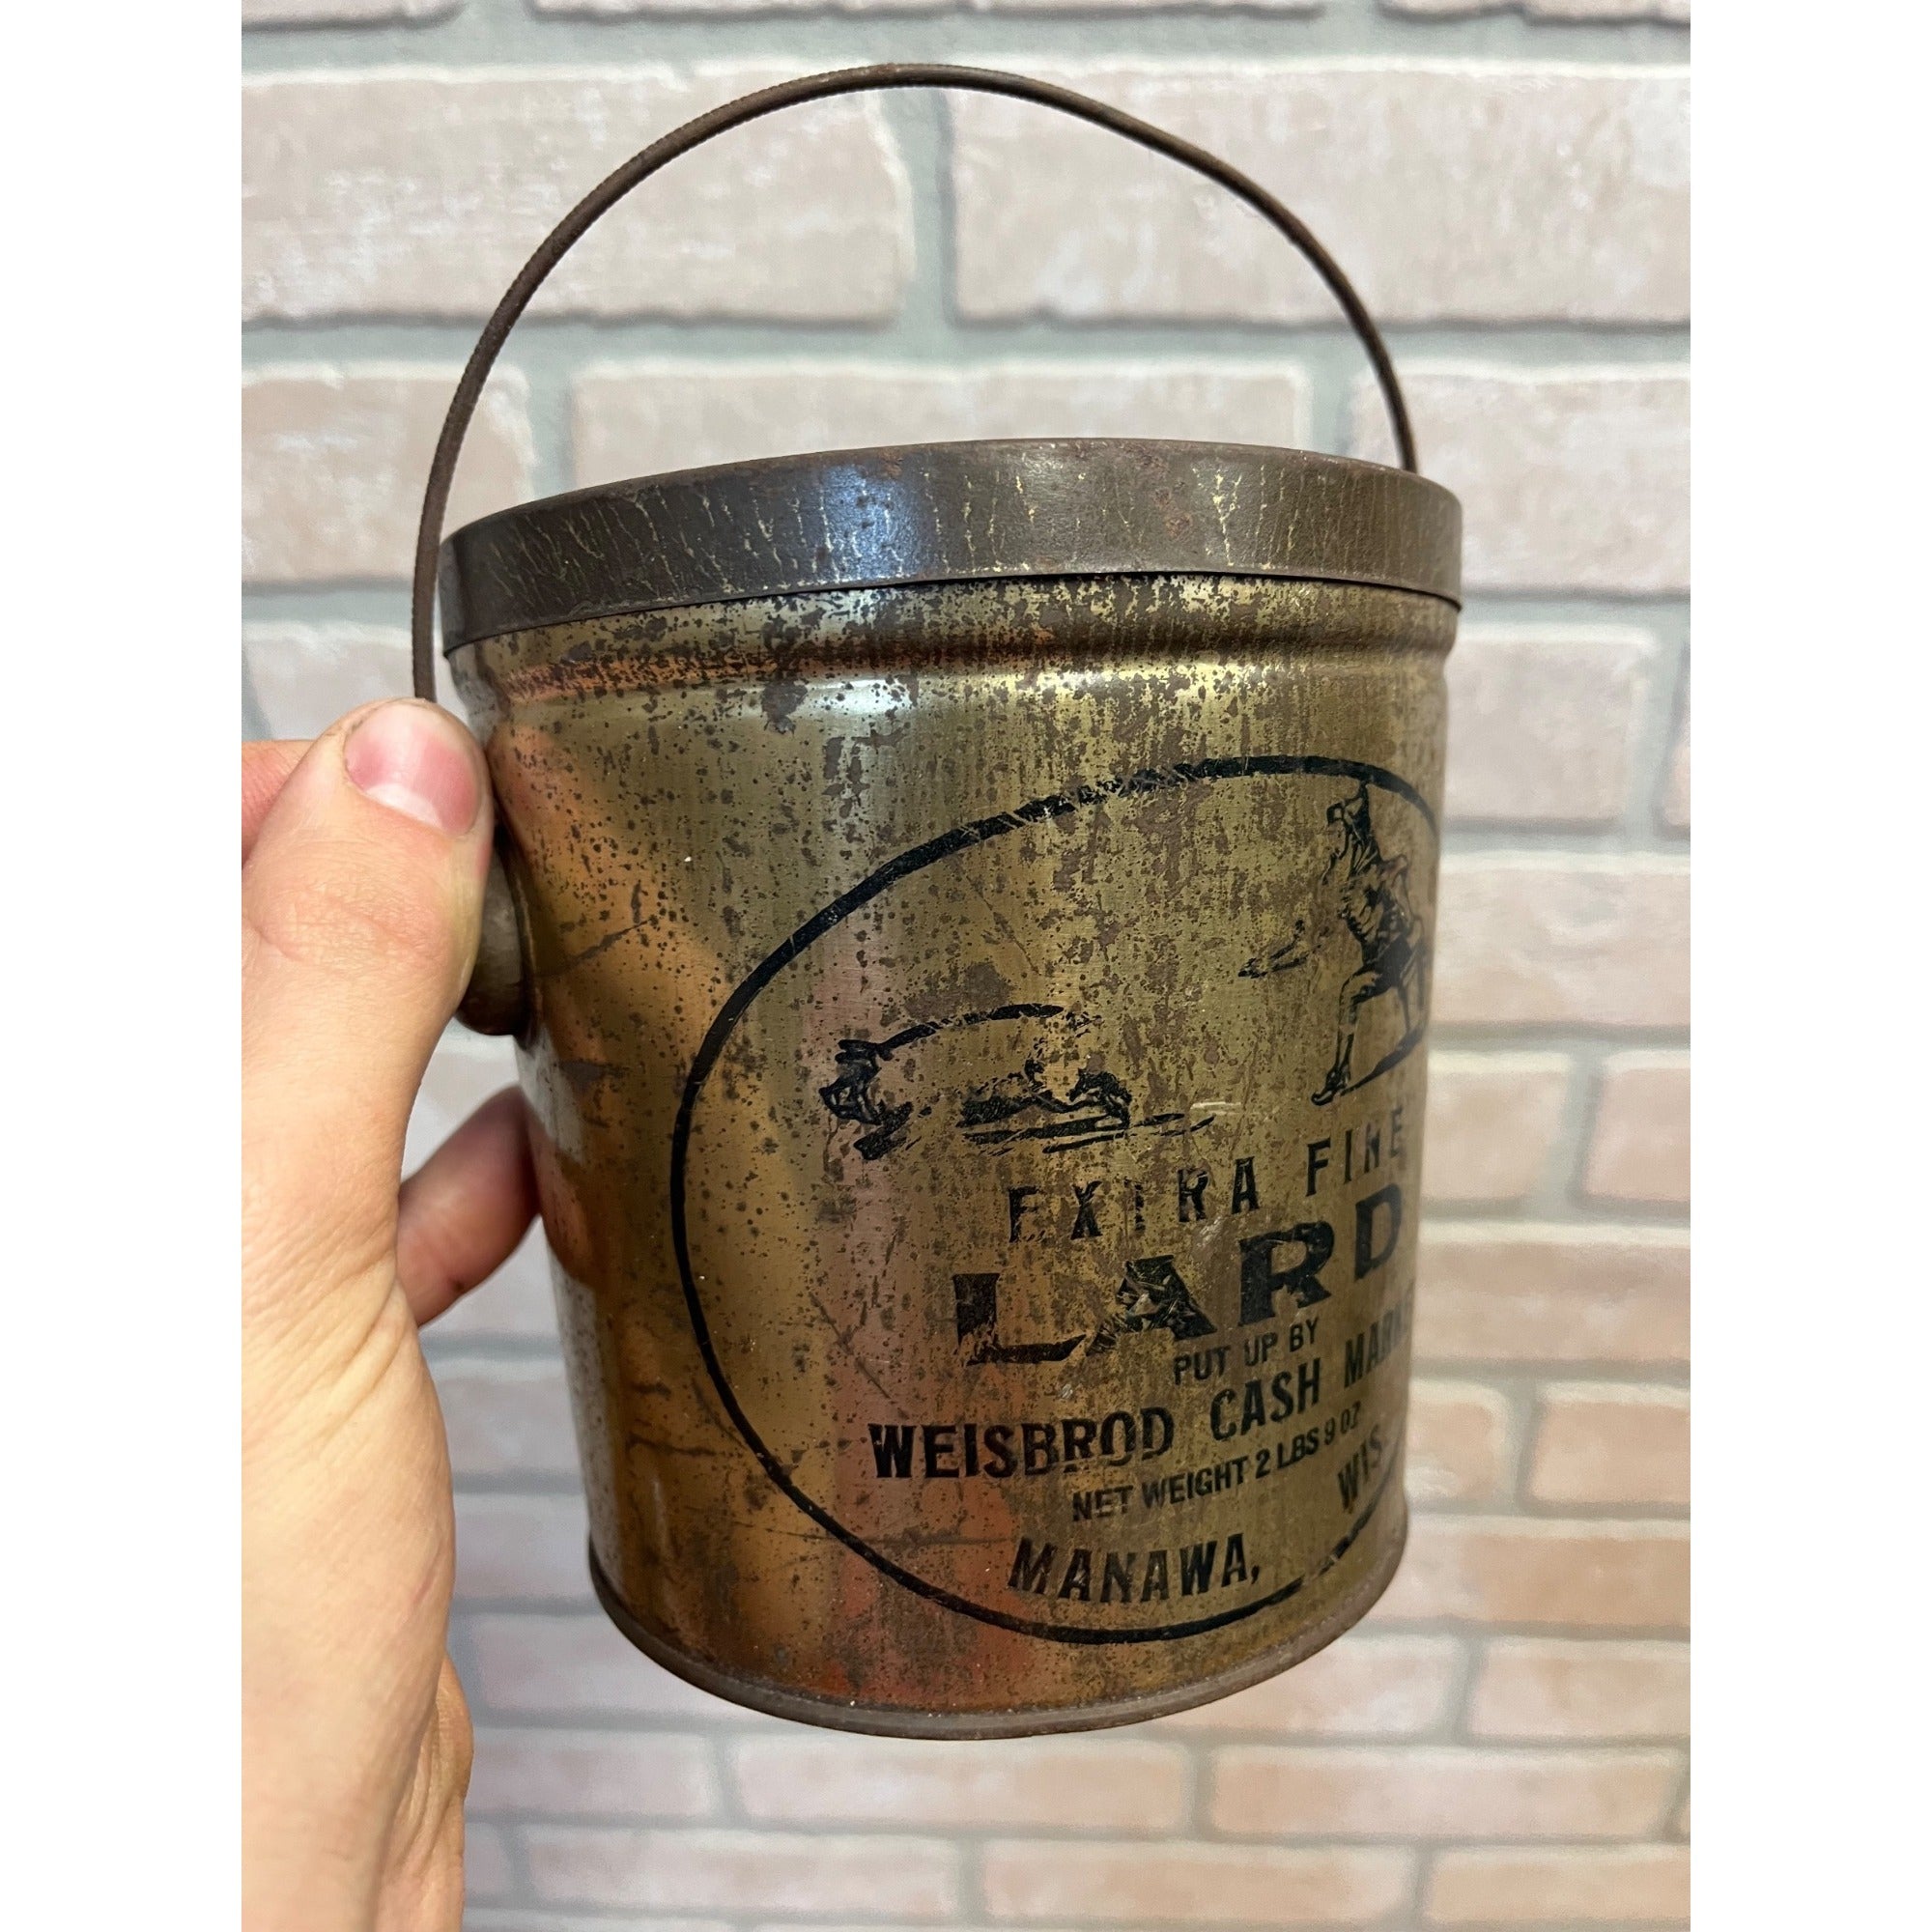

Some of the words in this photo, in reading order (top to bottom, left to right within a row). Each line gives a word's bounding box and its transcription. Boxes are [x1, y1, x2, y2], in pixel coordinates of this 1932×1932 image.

[1305, 1107, 1405, 1197] FINE
[952, 1182, 1405, 1366] LARD
[1173, 1346, 1231, 1385] PUT
[1244, 1331, 1278, 1367] UP
[1289, 1317, 1320, 1353] BY
[867, 1406, 1176, 1480] WEISBROD
[1209, 1357, 1321, 1442] CASH
[1071, 1485, 1134, 1522] NET
[1141, 1456, 1248, 1508] WEIGHT
[1255, 1448, 1271, 1480] 2
[1276, 1427, 1320, 1469] LBS
[1323, 1417, 1337, 1446] 9
[1008, 1533, 1261, 1604] MANAWA,
